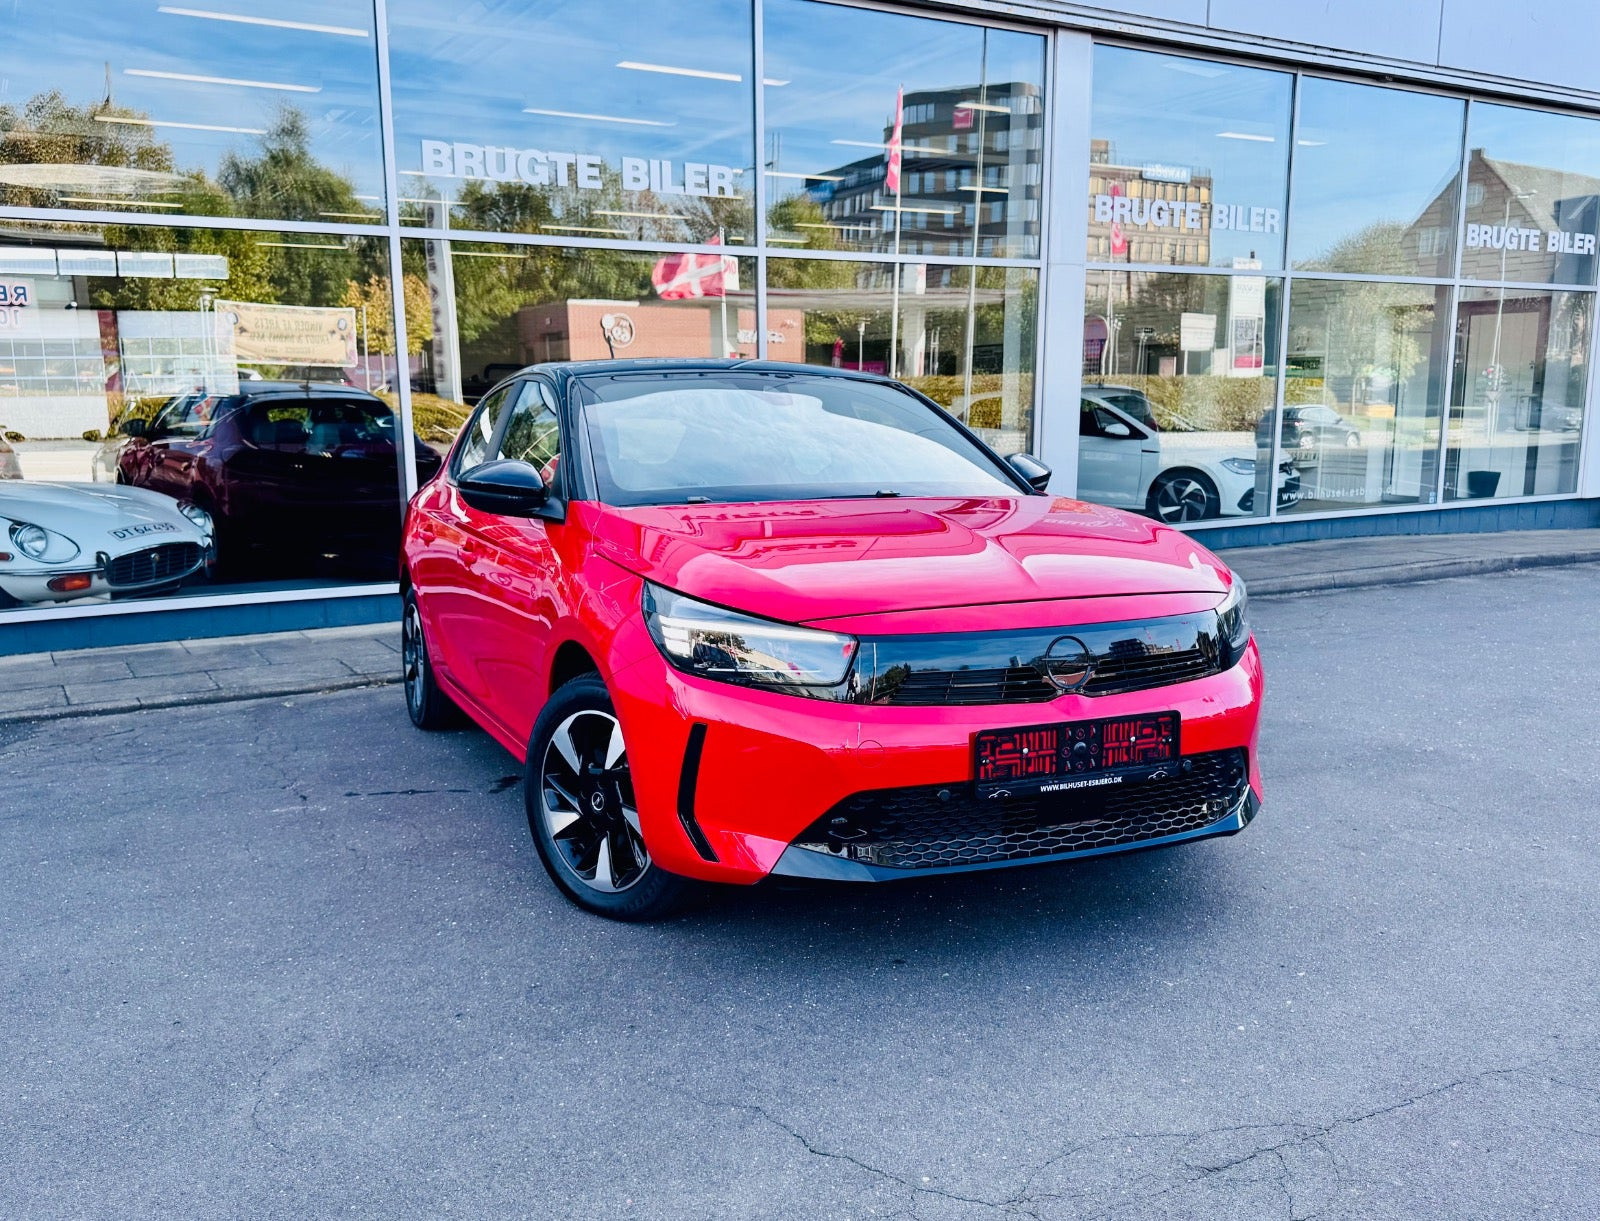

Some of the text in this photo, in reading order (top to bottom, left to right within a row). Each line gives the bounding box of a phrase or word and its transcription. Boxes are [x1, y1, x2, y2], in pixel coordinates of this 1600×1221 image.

[421, 139, 734, 196] BRUGTE BILER
[1095, 194, 1280, 234] BRUGTE BILER
[1466, 223, 1596, 255] BRUGTE BILER
[113, 528, 134, 539] DT
